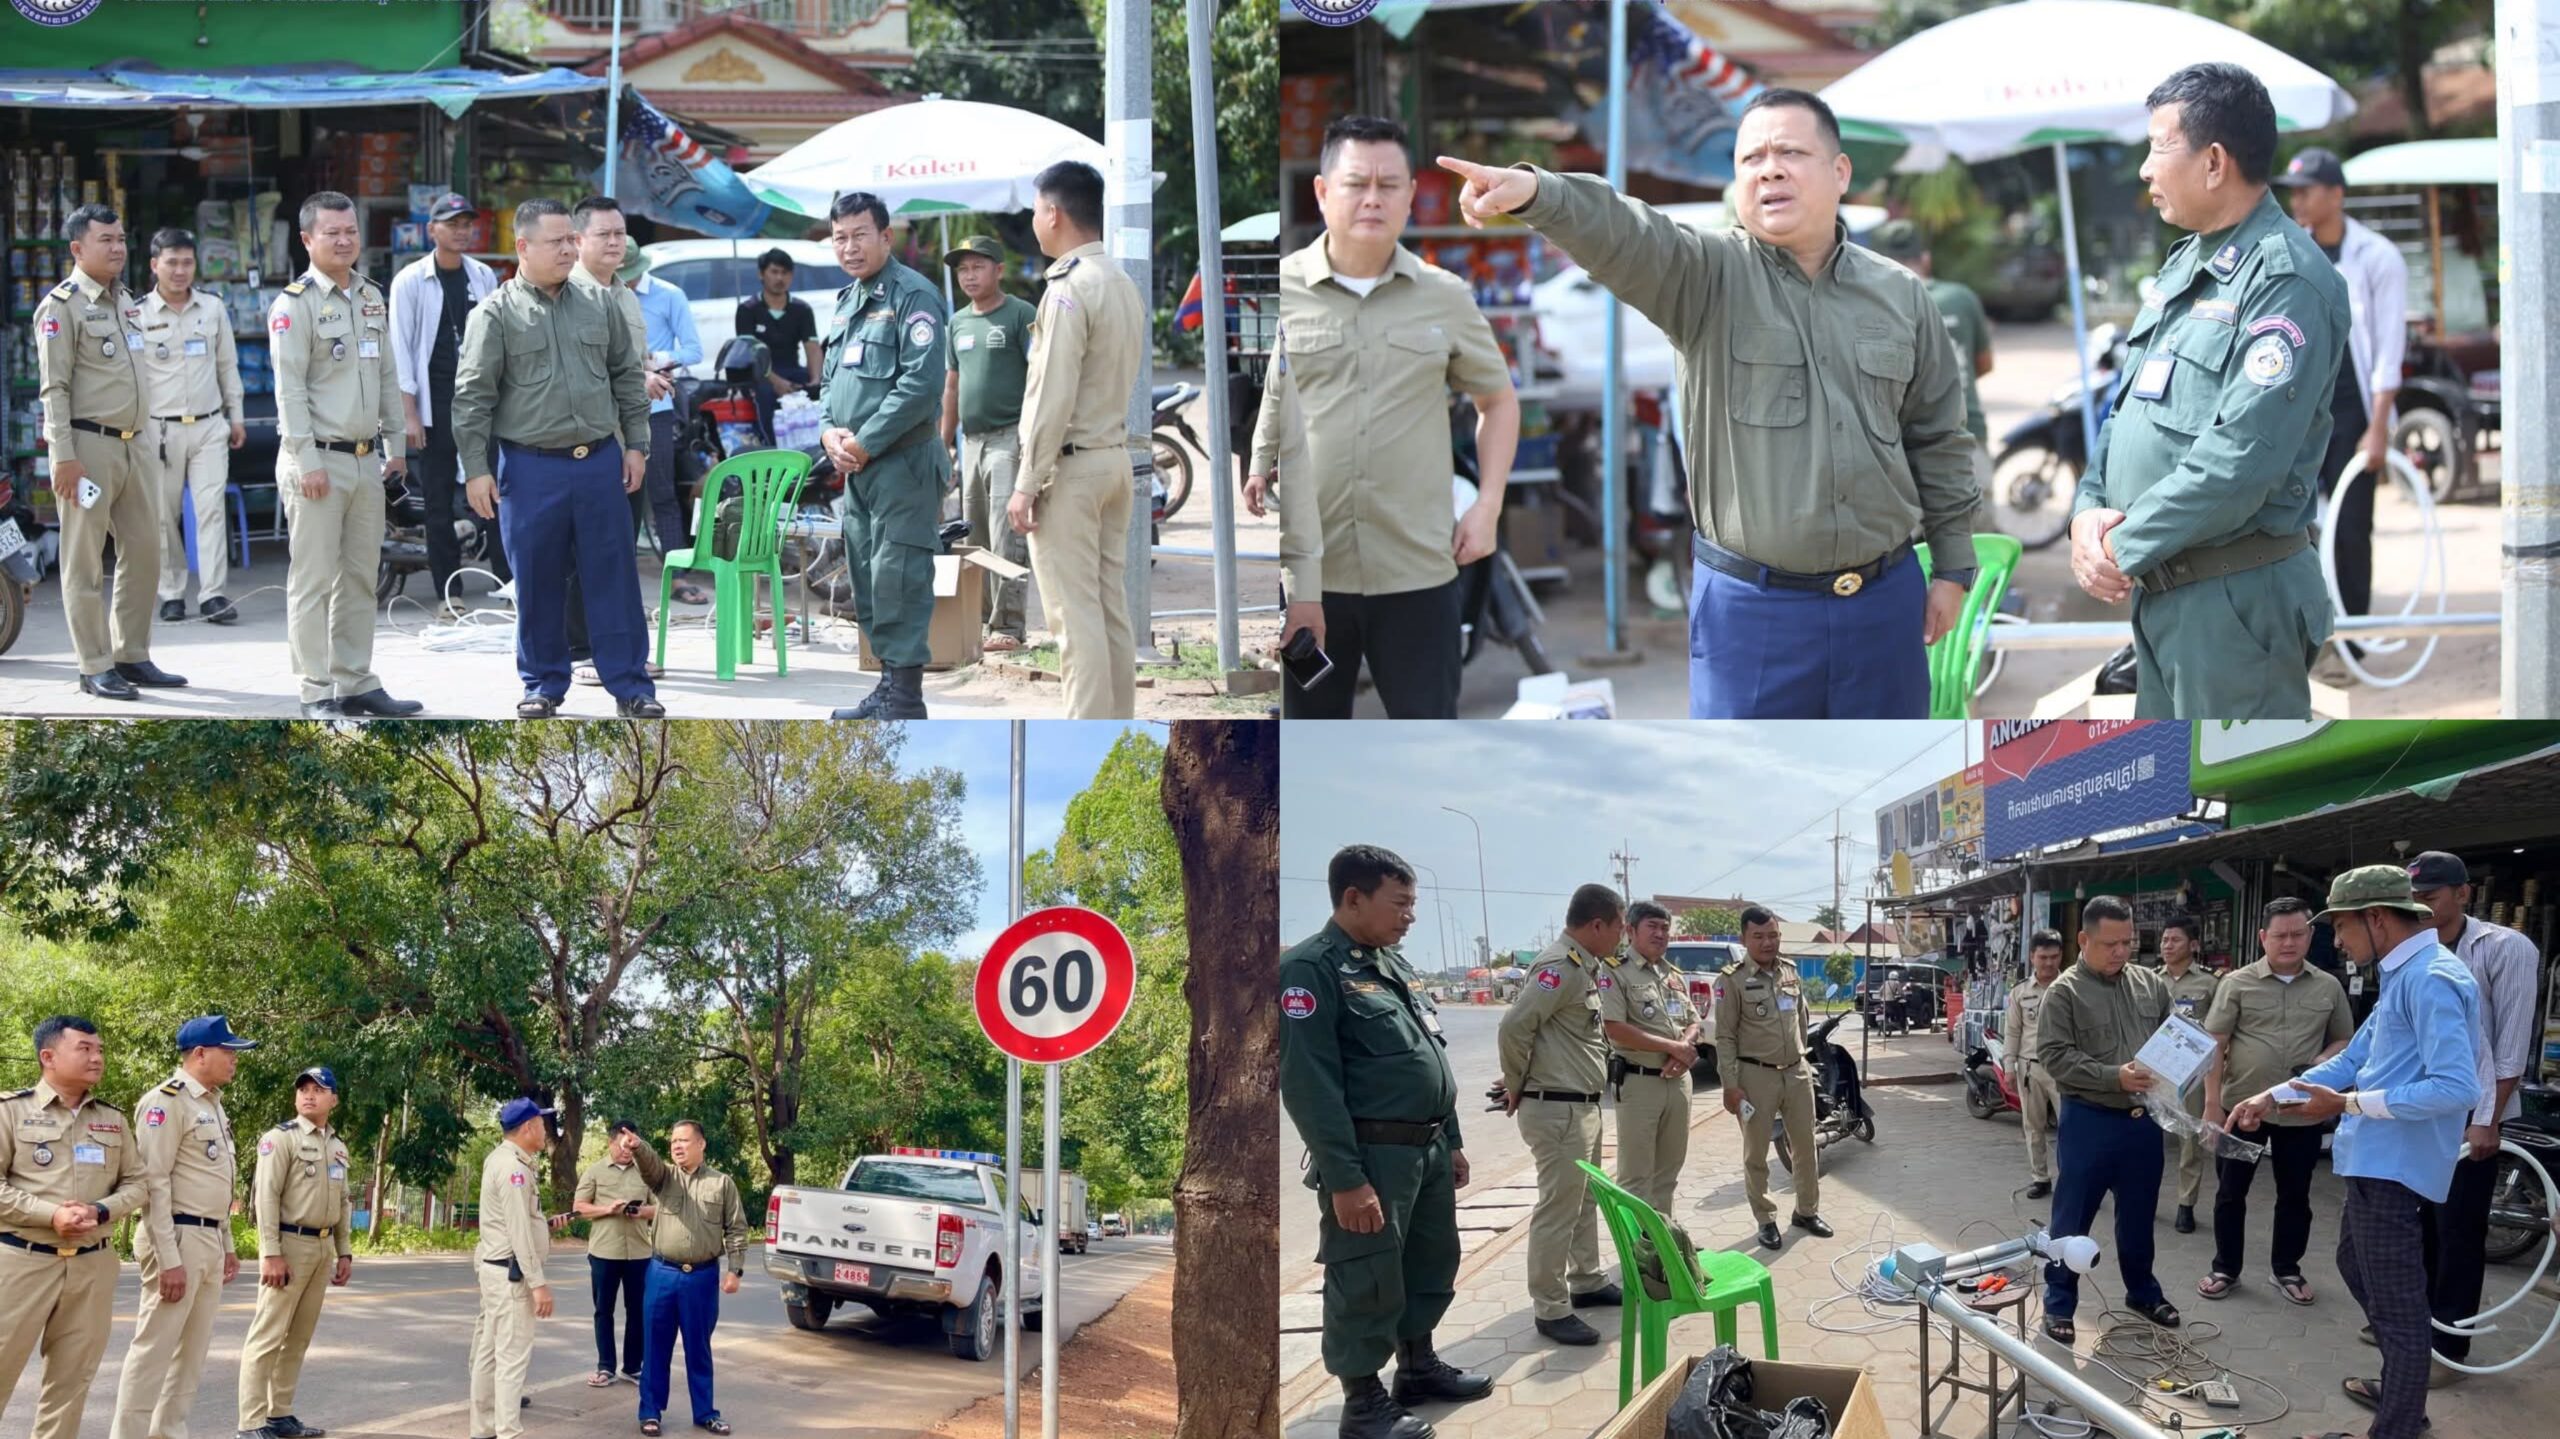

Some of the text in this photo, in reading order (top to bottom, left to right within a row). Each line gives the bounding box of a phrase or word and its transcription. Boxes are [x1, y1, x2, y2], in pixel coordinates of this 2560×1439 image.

[887, 160, 976, 178] Kulen
[2088, 720, 2108, 740] 012
[1008, 949, 1095, 1017] 60
[781, 1231, 932, 1260] RANGER
